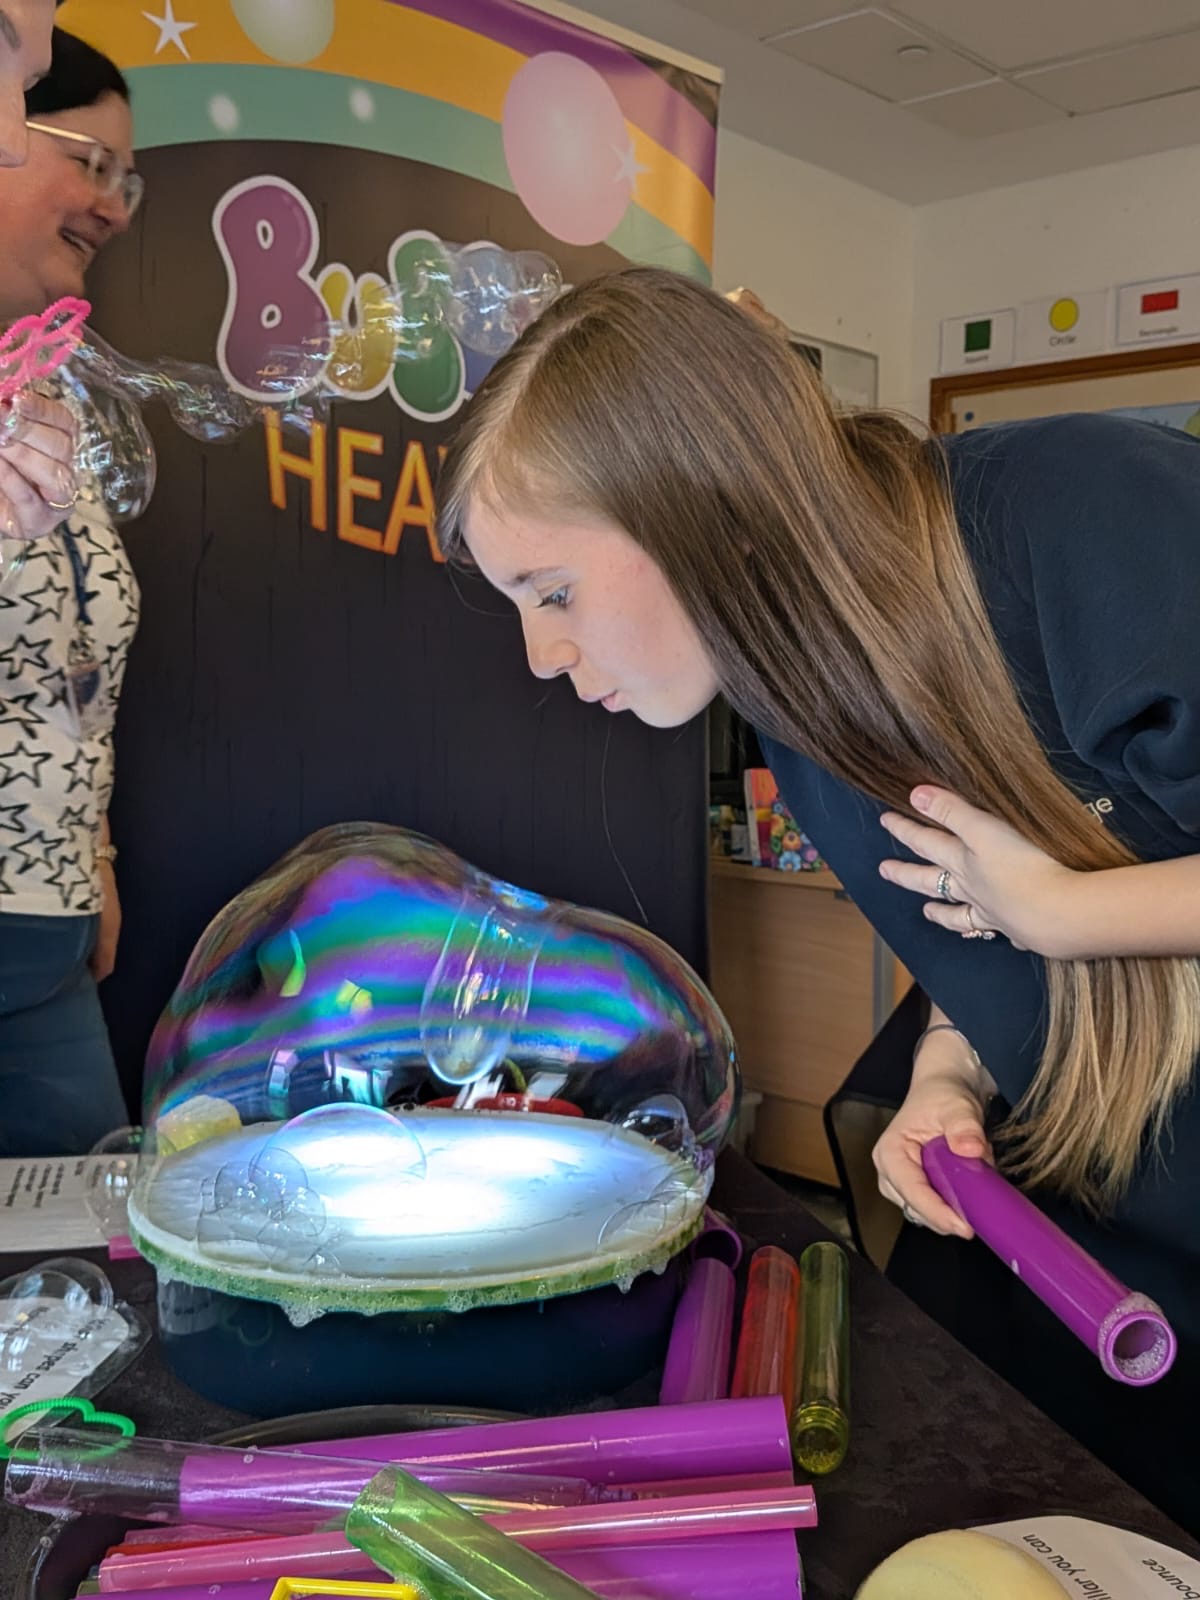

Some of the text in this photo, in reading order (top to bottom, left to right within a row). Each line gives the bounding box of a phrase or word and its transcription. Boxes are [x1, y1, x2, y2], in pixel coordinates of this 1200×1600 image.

[264, 407, 448, 563] HEA
[13, 1372, 40, 1390] can
[1022, 1533, 1053, 1554] can
[1047, 1553, 1086, 1577] you
[1141, 1557, 1200, 1600] bounce
